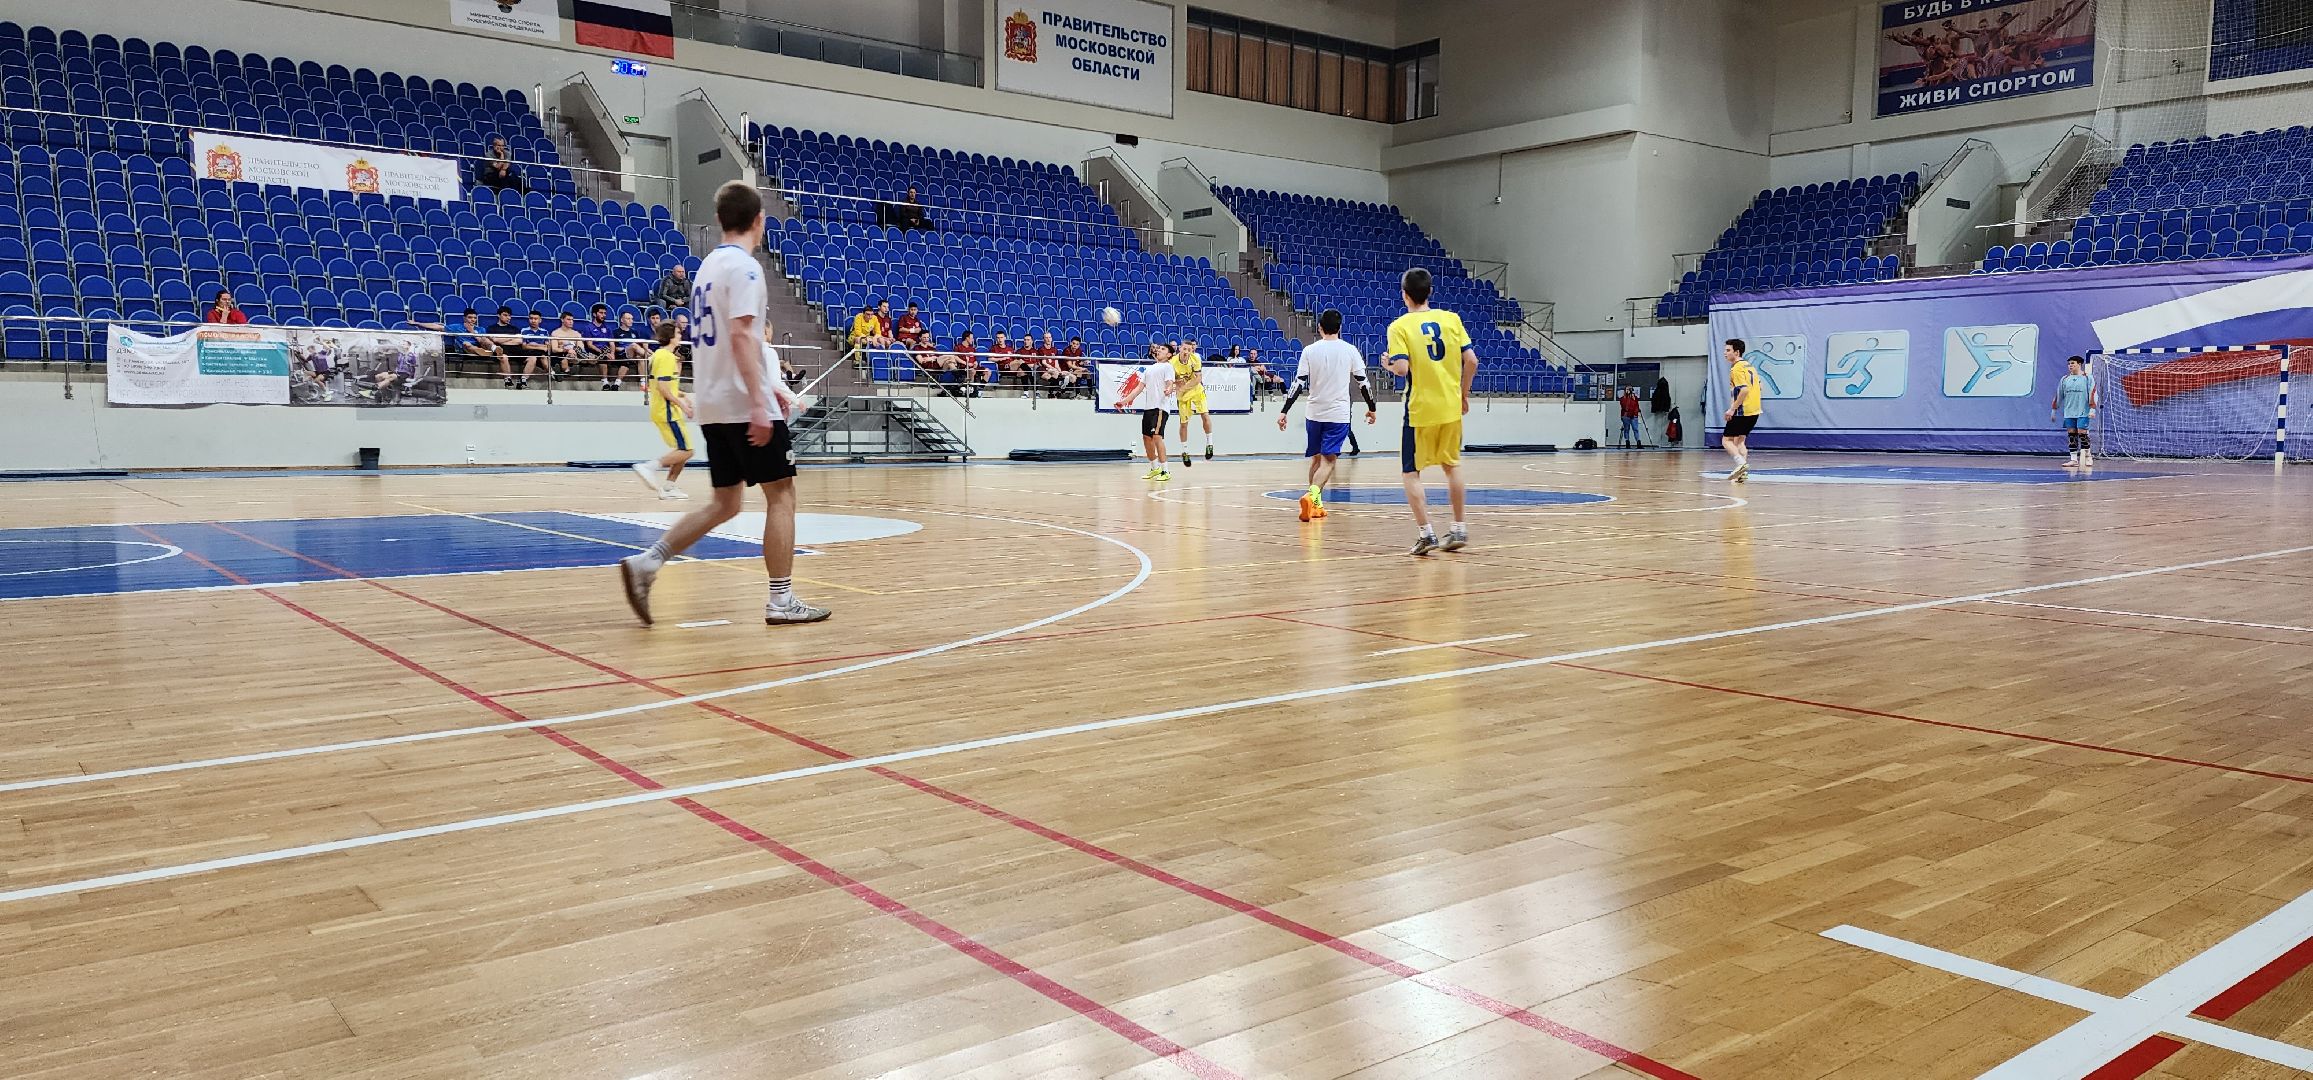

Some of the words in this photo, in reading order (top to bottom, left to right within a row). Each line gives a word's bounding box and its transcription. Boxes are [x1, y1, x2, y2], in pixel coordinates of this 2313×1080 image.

[1904, 0, 1953, 19] БУДЬ
[1042, 11, 1167, 48] ПРАВИТЕЛЬСТВО
[1055, 33, 1155, 64] МОСКОВСКОЙ
[1071, 57, 1140, 80] ОБЛАСТИ
[1899, 86, 1960, 108] ЖИВИ
[1968, 67, 2075, 98] СПОРТОМ
[1421, 321, 1446, 362] 3
